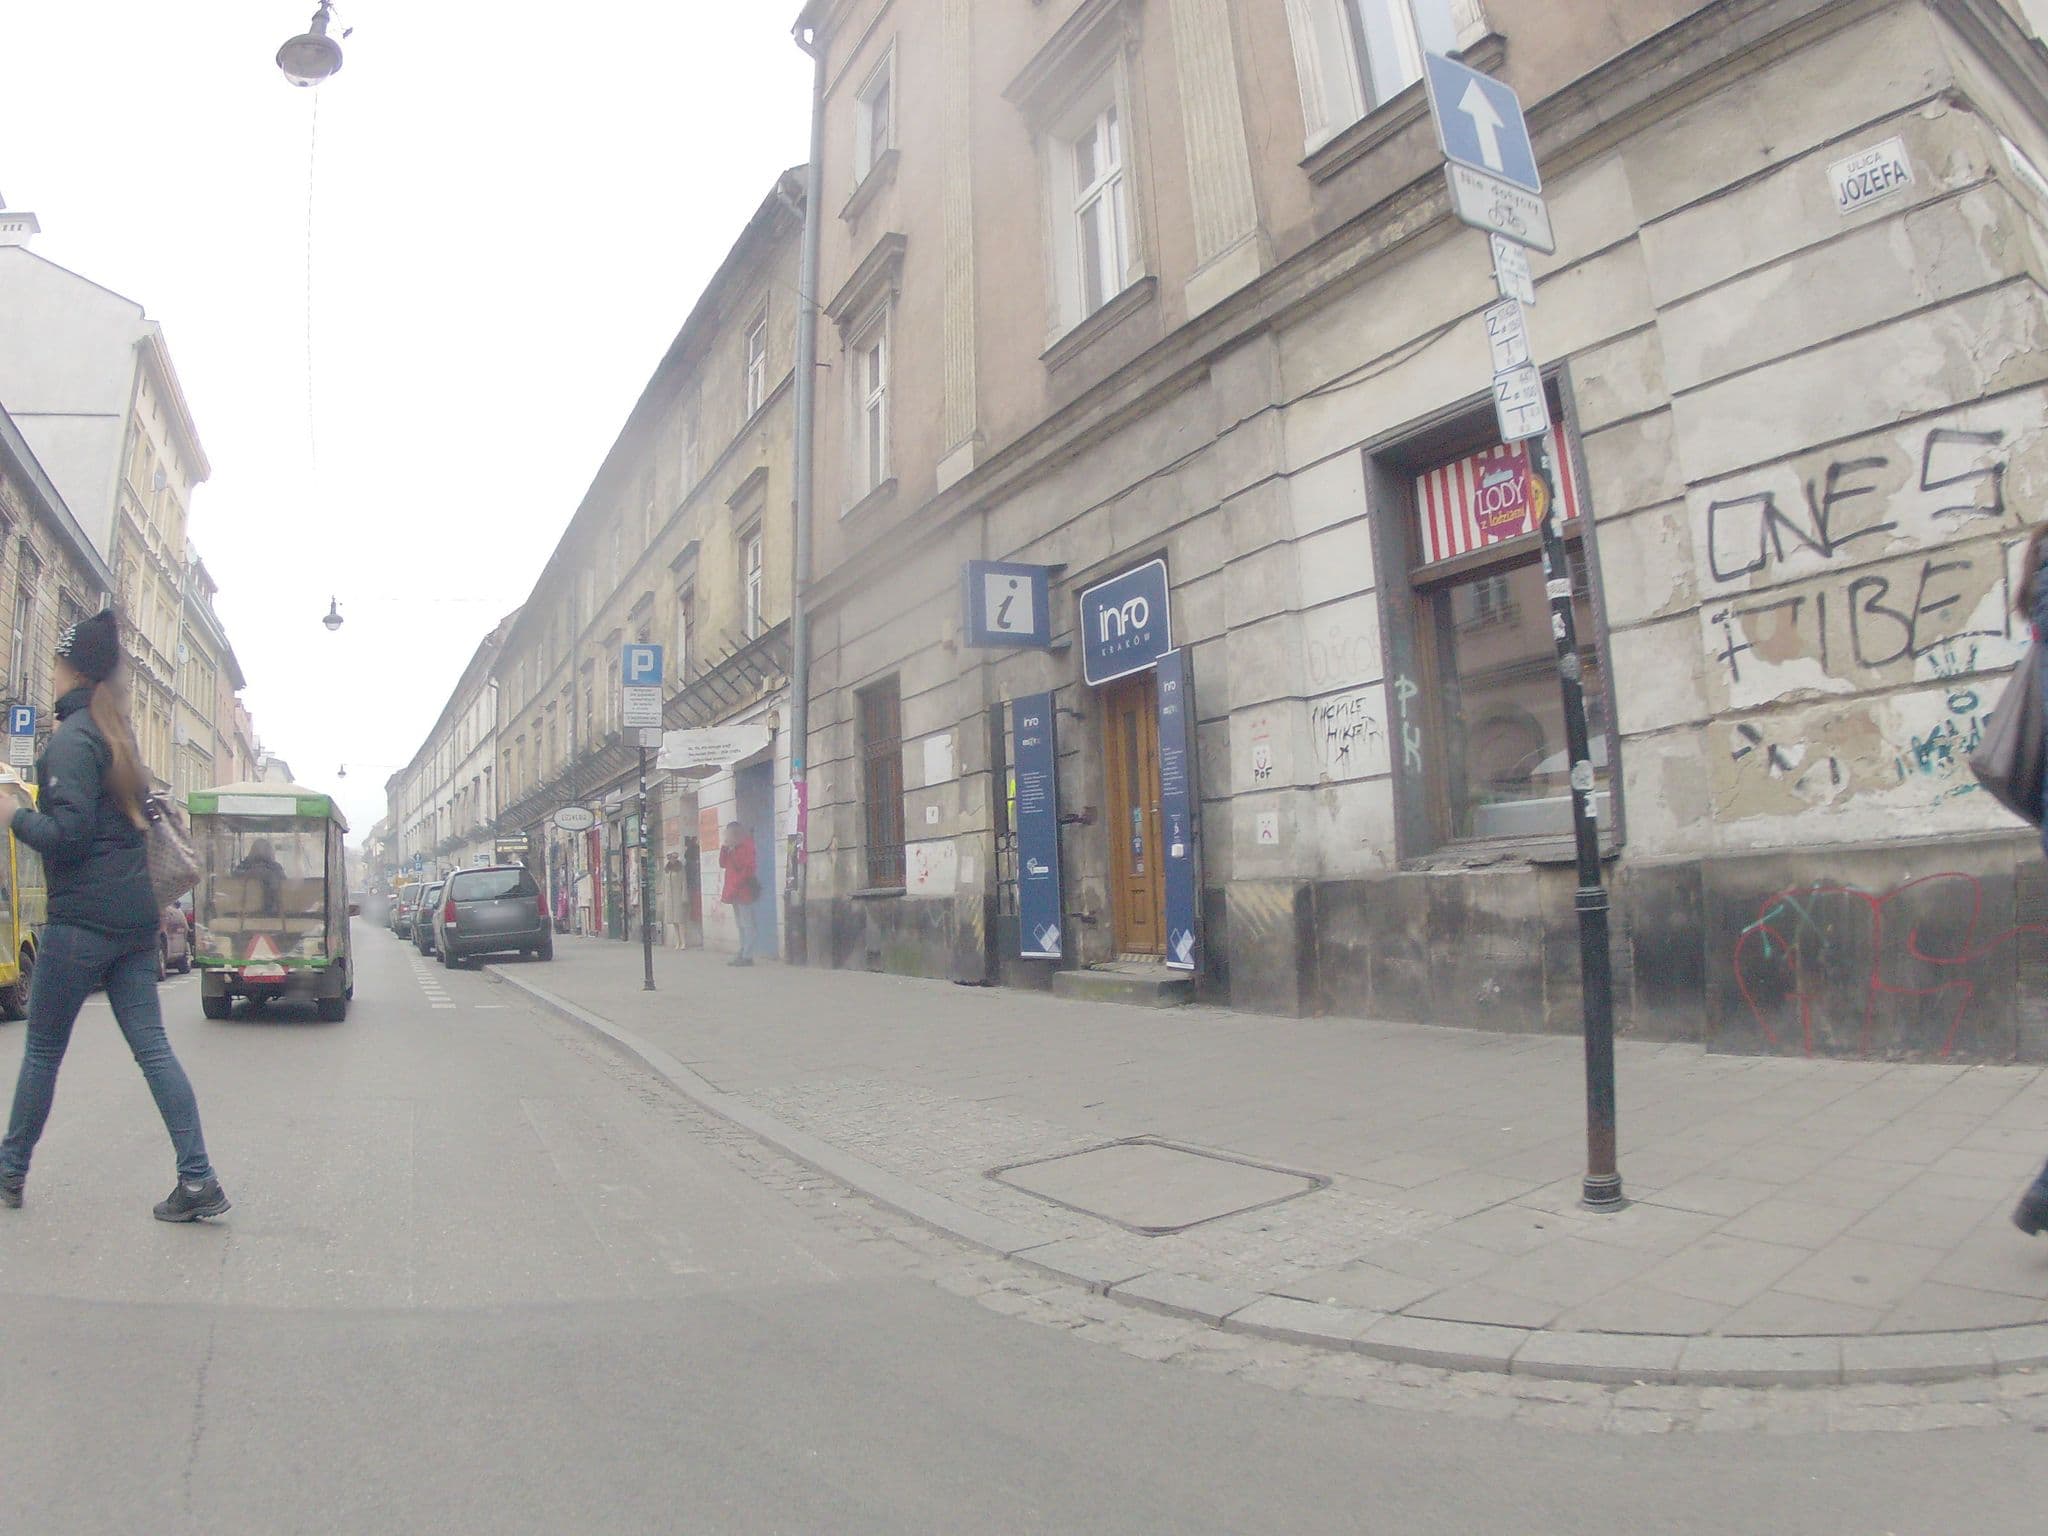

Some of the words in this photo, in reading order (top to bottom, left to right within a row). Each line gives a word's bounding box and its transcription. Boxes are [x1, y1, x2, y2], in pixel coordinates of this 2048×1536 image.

[1475, 476, 1524, 515] LODY
[1098, 595, 1150, 643] info
[631, 650, 654, 681] P
[15, 709, 31, 733] P
